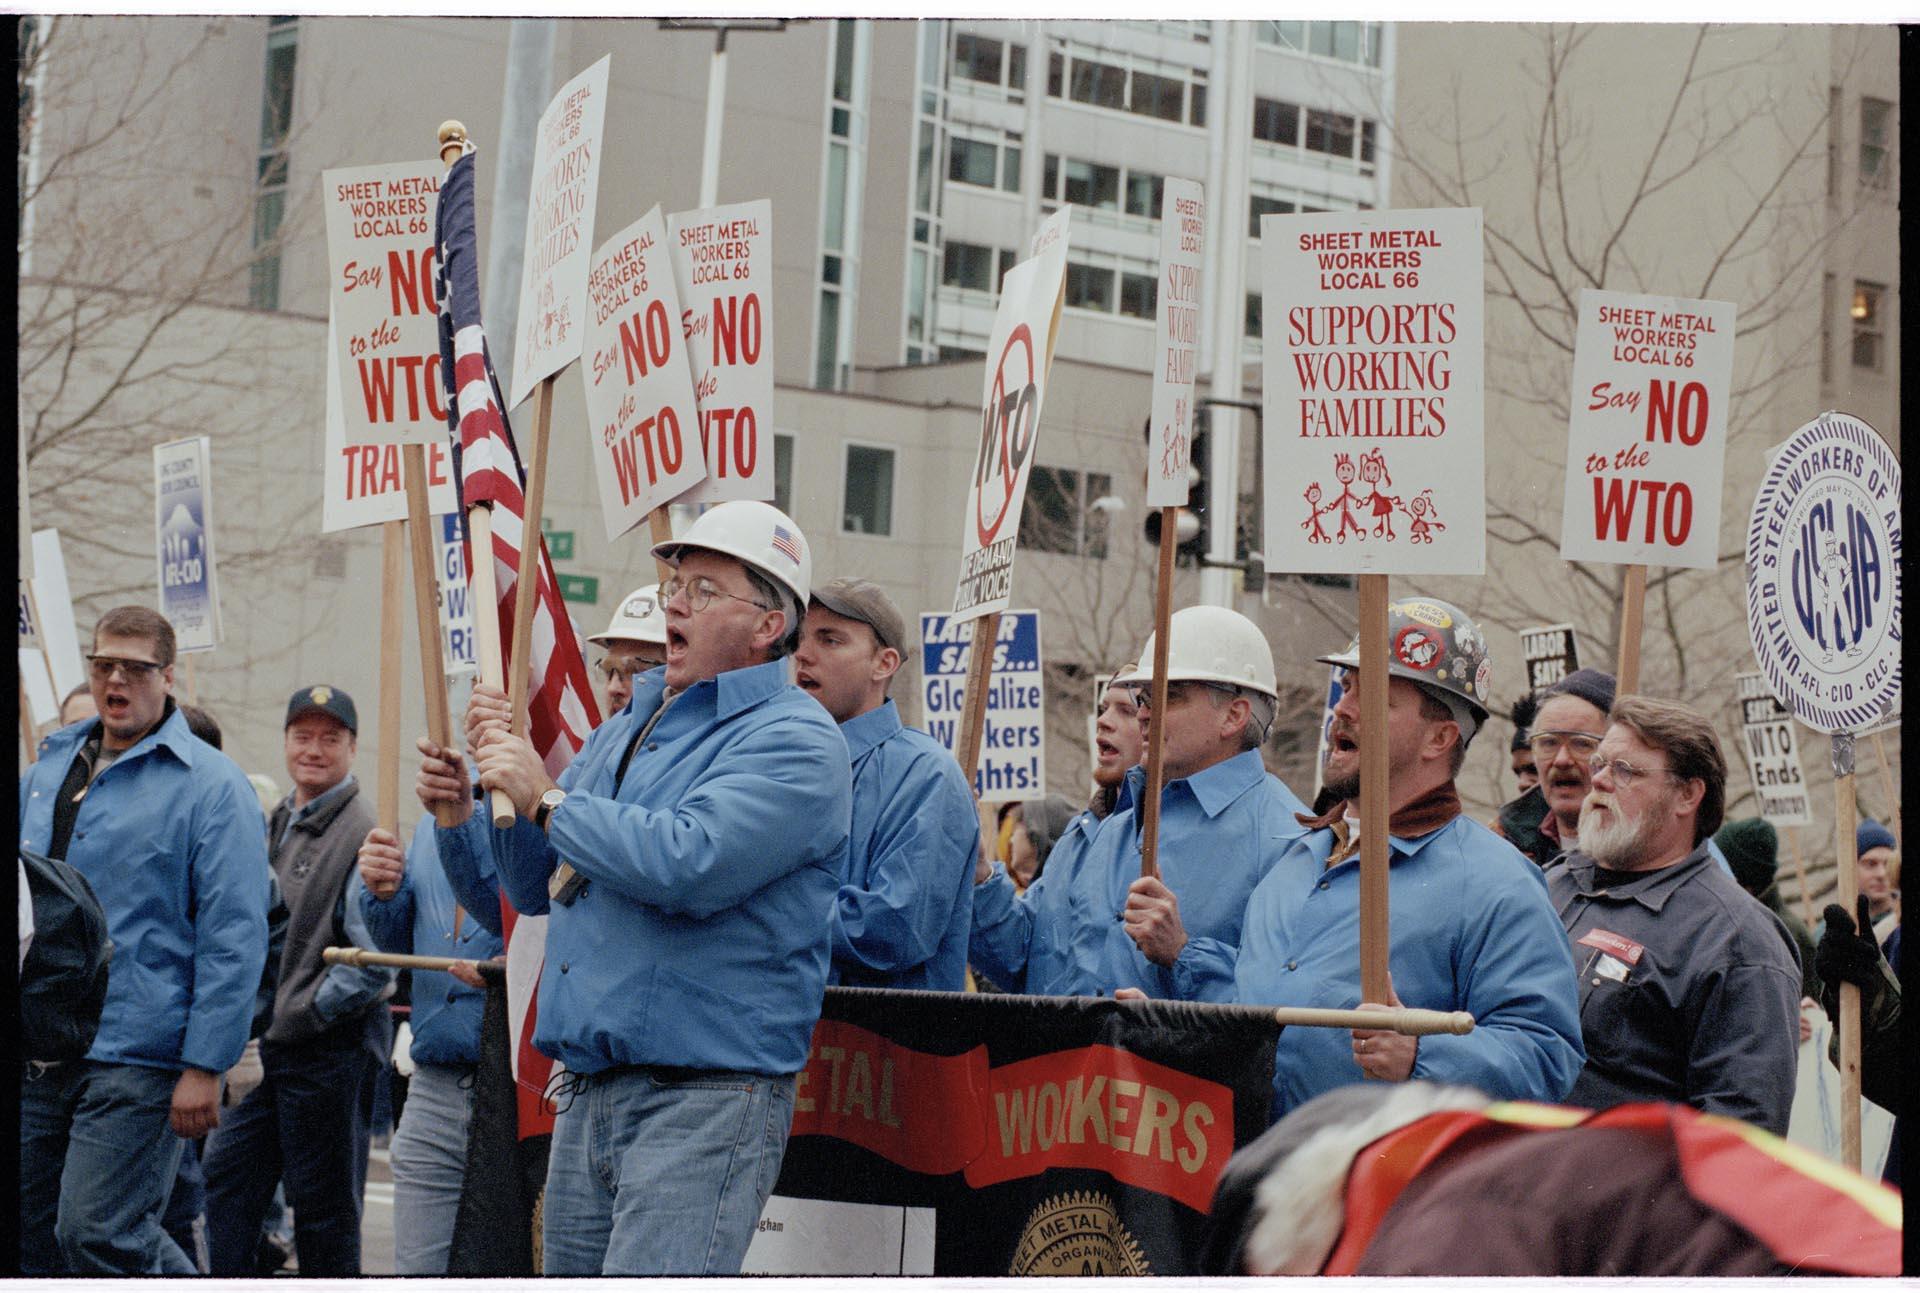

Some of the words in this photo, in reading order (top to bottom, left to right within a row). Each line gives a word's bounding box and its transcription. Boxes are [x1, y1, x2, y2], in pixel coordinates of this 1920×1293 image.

[338, 180, 383, 202] SHEET
[388, 176, 441, 198] METAL
[350, 197, 427, 219] WORKERS
[353, 220, 405, 240] LOCAL
[409, 216, 428, 235] 66
[680, 223, 715, 248] SHEET
[717, 218, 760, 241] METAL
[1299, 231, 1364, 252] SHEET
[1370, 230, 1442, 249] METAL
[588, 254, 611, 293] HEET
[613, 231, 655, 268] METAL
[691, 239, 751, 263] WORKERS
[1317, 251, 1422, 271] WORKERS
[343, 260, 384, 293] Say
[592, 257, 647, 306] WORKERS
[692, 262, 730, 285] LOCAL
[734, 261, 751, 281] 66
[1320, 271, 1386, 291] LOCAL
[1393, 271, 1420, 289] 66
[595, 291, 631, 328] LOCAL
[633, 277, 649, 299] 66
[1599, 305, 1656, 327] SHEET
[1660, 313, 1716, 334] METAL
[350, 334, 368, 357] to
[371, 318, 401, 350] the
[713, 292, 762, 368] NO
[1288, 302, 1457, 347] SUPPORTS
[1613, 326, 1697, 350] WORKERS
[592, 339, 620, 388] Say
[618, 299, 672, 387] NO
[1613, 345, 1670, 367] LOCAL
[1674, 351, 1694, 369] 66
[357, 353, 450, 424] WTO
[1292, 350, 1452, 393] WORKING
[603, 422, 617, 449] to
[616, 393, 636, 430] the
[1298, 396, 1448, 439] FAMILIES
[1588, 381, 1641, 414] Say
[1645, 378, 1710, 447] NO
[975, 382, 1037, 490] WTO
[342, 442, 447, 502] TRAE
[611, 405, 683, 508] WTO
[1585, 451, 1609, 475] to
[1614, 442, 1650, 472] the
[1867, 468, 1889, 501] OF
[1593, 475, 1693, 548] WTO
[1762, 446, 1865, 570] STEELWORKERS
[924, 614, 1019, 645] LABR
[1762, 581, 1801, 678] UNITED
[937, 644, 1037, 675] SAS...
[1801, 671, 1822, 699] AFL
[1831, 683, 1854, 703] CIO
[1865, 659, 1890, 691] CLC
[928, 718, 1041, 751] Wkers
[1748, 724, 1792, 758] WTO
[1755, 760, 1801, 787] Ends
[795, 1046, 901, 1129] ETAL
[1040, 1213, 1103, 1242] METAL
